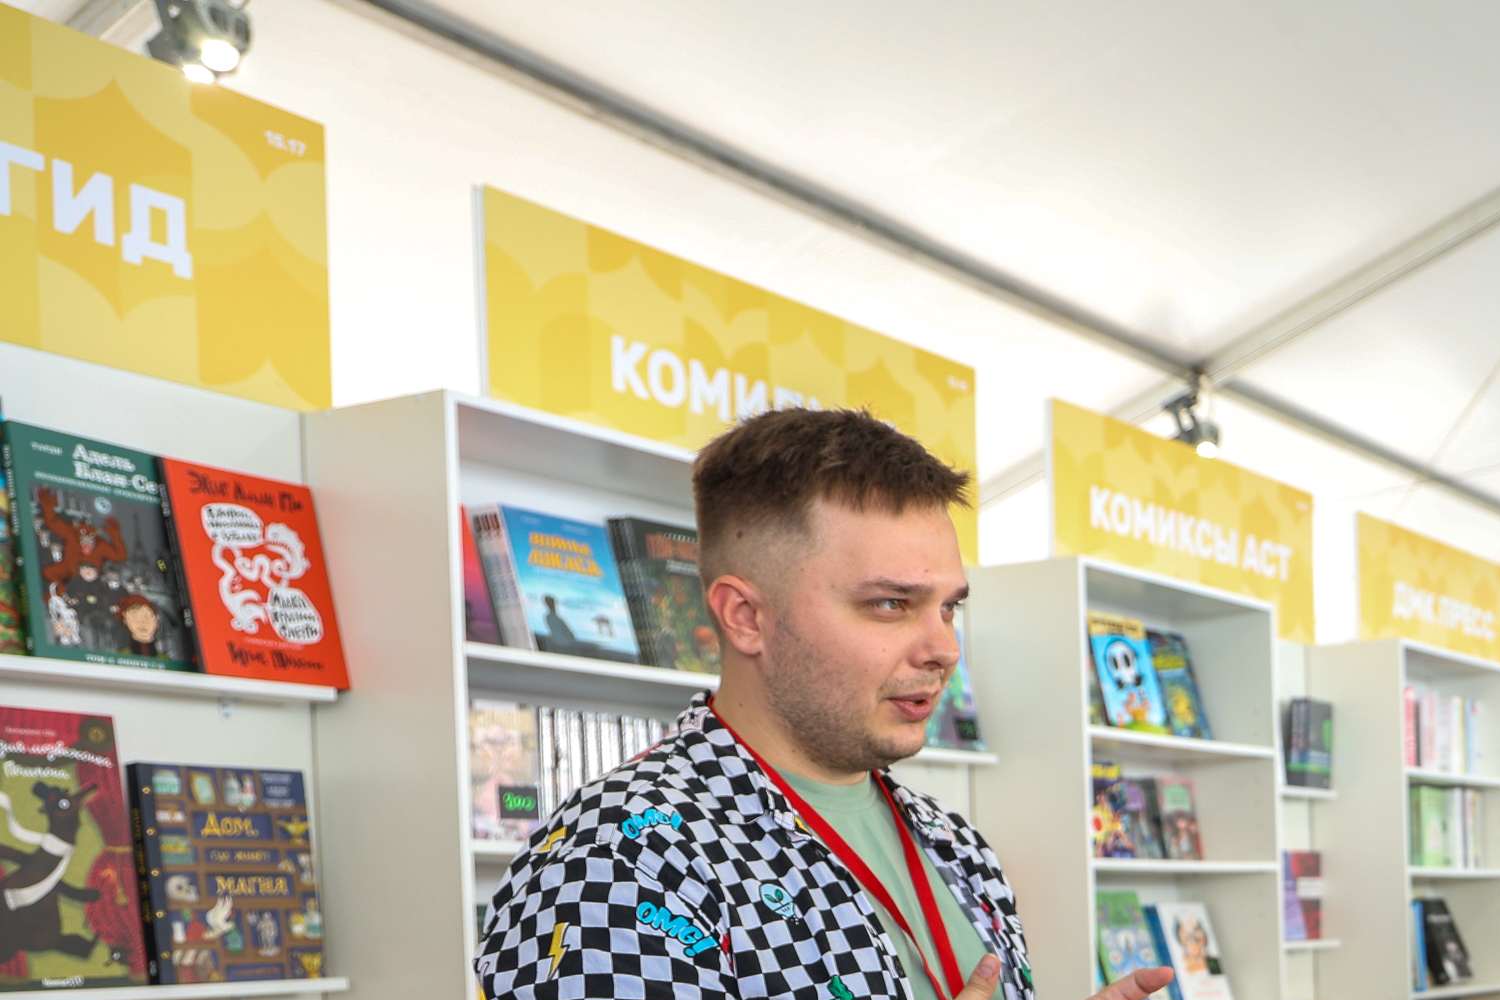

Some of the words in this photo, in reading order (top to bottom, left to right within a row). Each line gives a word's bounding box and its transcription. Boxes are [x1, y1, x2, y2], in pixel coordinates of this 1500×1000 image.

[1090, 485, 1239, 569] КОМИКСЫ
[1242, 535, 1292, 582] АСТ
[1438, 594, 1497, 642] ПРЕСС
[622, 809, 683, 839] OMG!
[636, 901, 718, 957] OMG!
